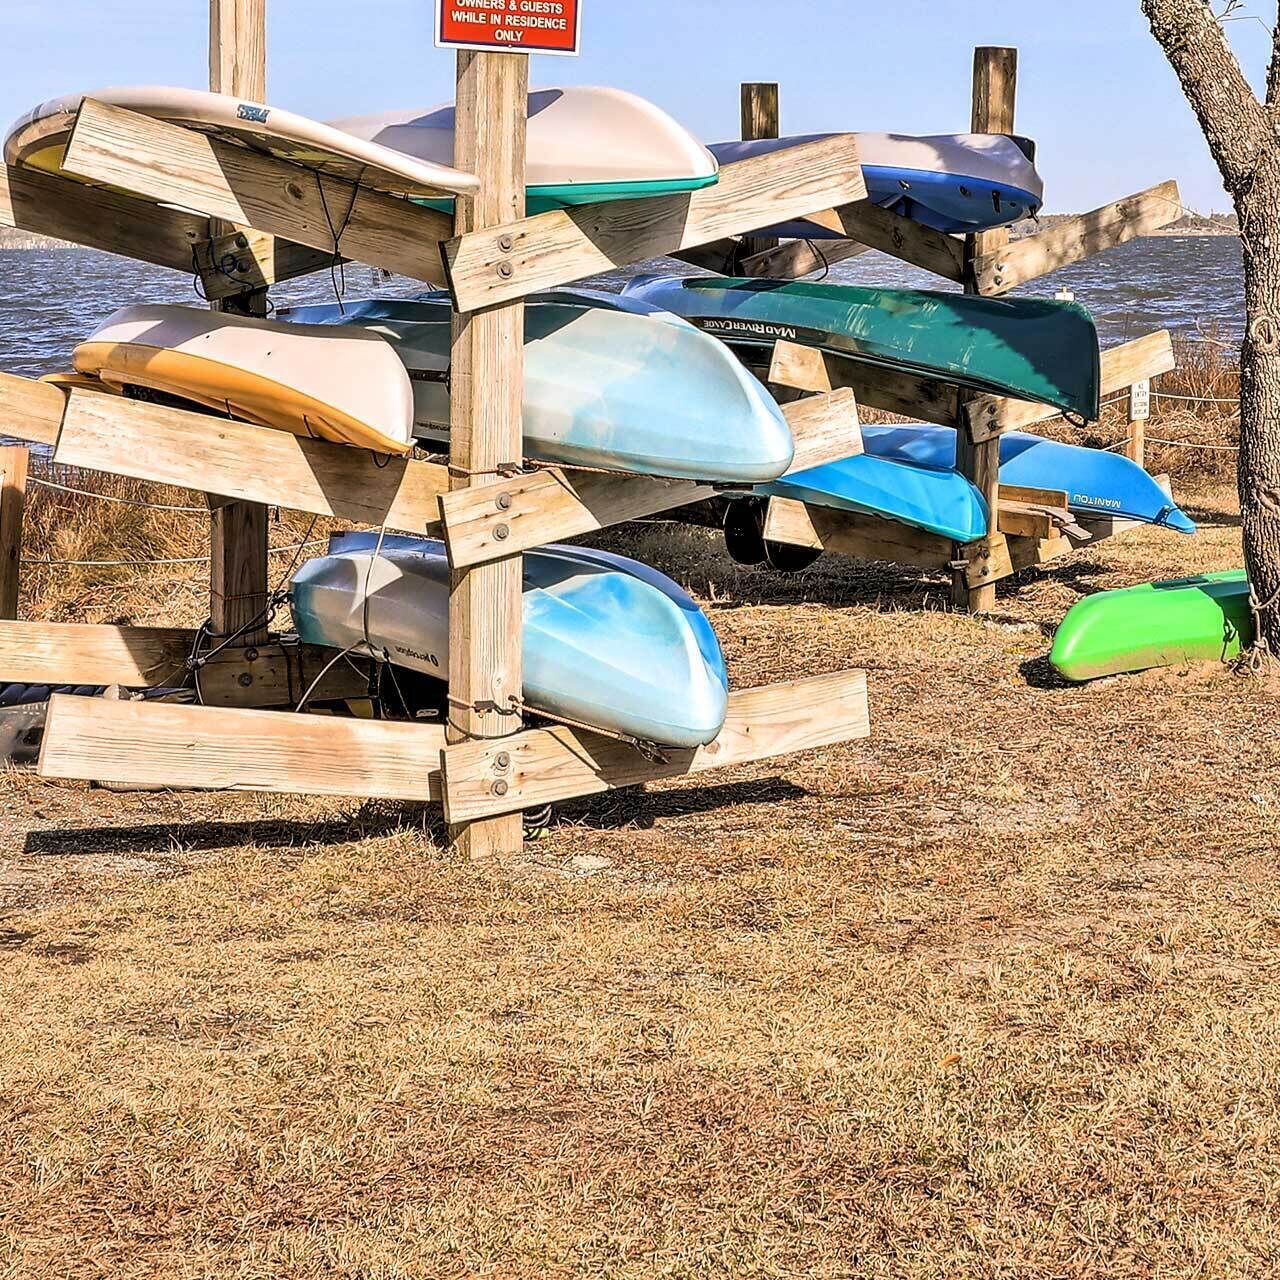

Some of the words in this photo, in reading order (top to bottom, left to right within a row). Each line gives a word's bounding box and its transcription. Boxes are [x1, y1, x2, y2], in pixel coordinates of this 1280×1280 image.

[509, 0, 517, 11] &
[520, 1, 563, 14] GUESTS
[451, 10, 486, 24] WHILE
[490, 13, 501, 25] IN
[505, 15, 567, 30] RESIDENCE
[494, 29, 523, 42] ONLY
[1073, 494, 1121, 509] MANITOU
